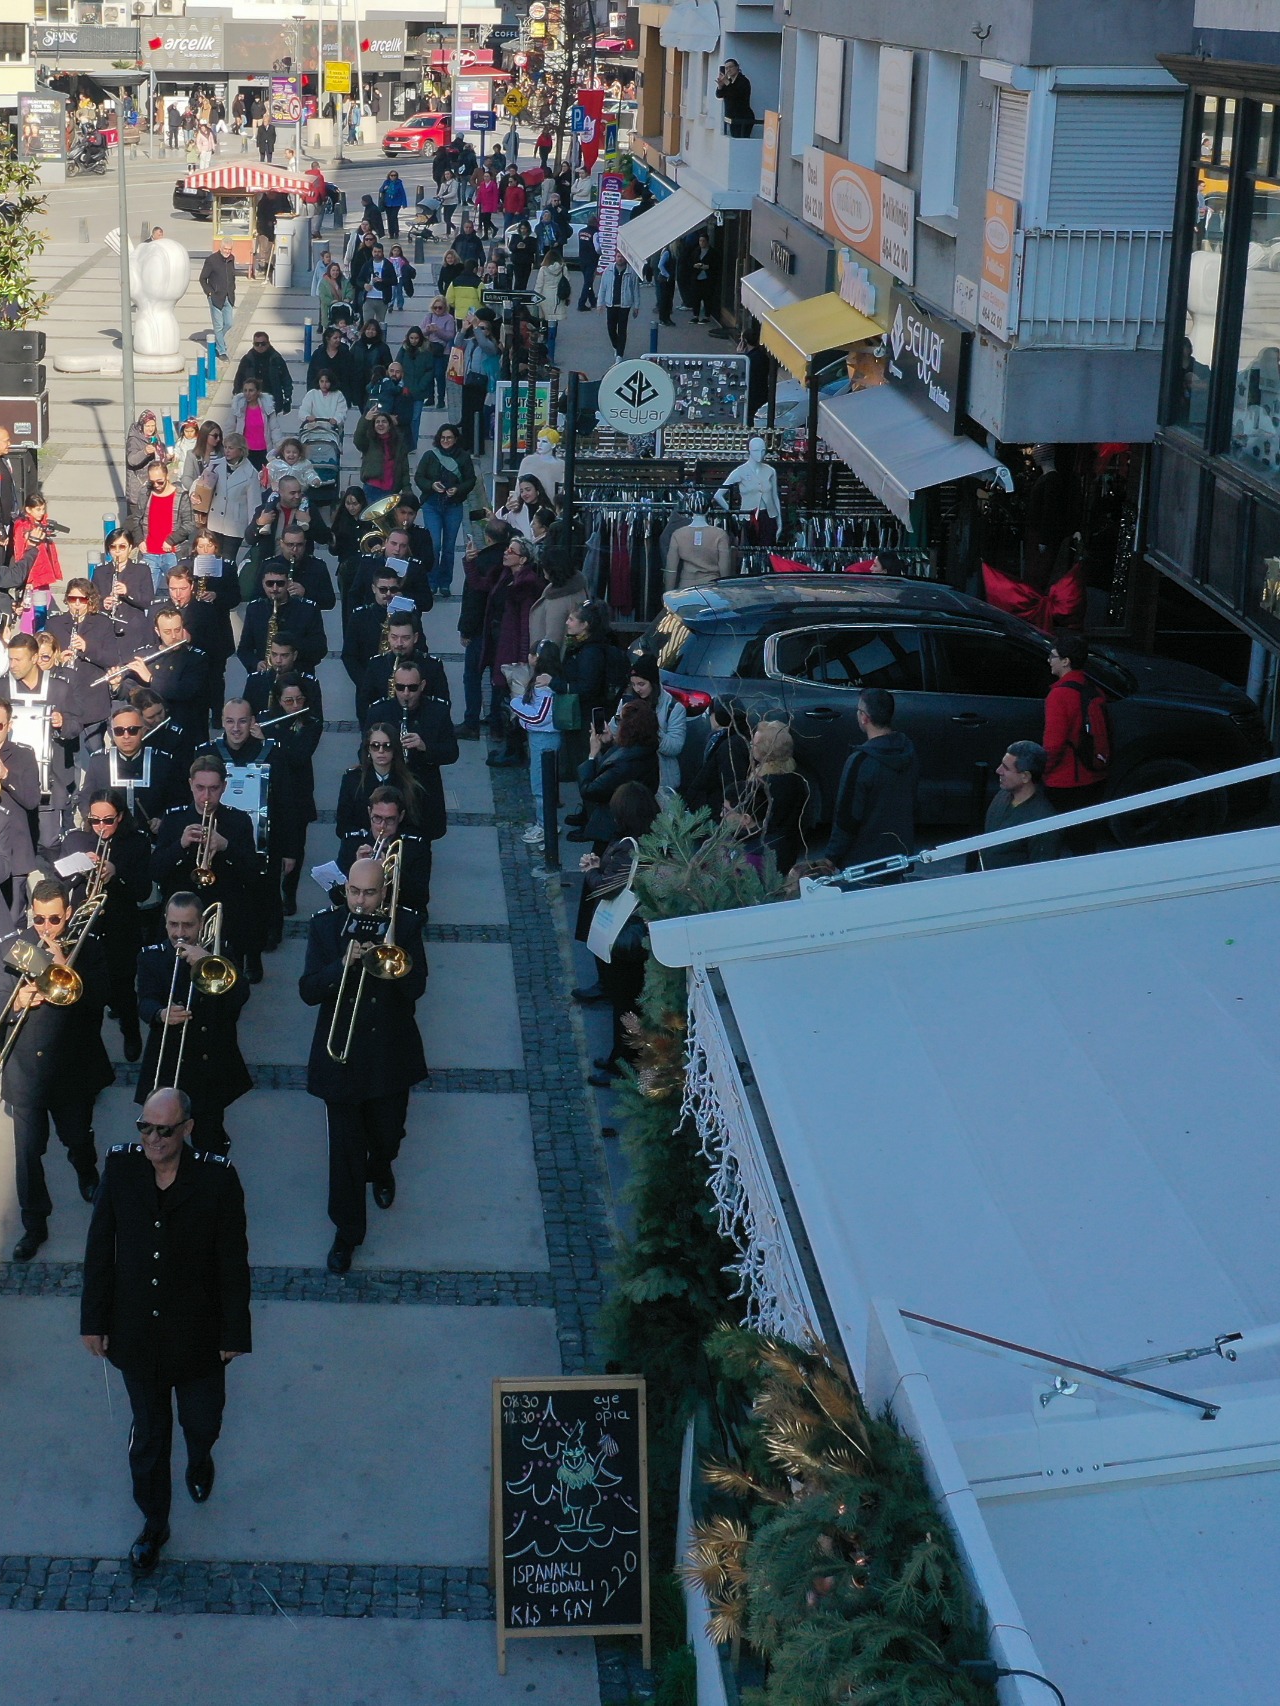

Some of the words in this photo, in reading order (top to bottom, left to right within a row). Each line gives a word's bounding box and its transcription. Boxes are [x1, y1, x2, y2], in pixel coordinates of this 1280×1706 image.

[164, 35, 215, 53] arçelik
[370, 38, 403, 54] arçelik
[574, 108, 582, 130] P
[882, 235, 892, 262] 464
[893, 242, 901, 268] 22
[901, 248, 909, 273] 00
[609, 407, 665, 425] seyyar
[593, 1394, 620, 1411] eye
[595, 1407, 630, 1427] opia
[512, 1561, 581, 1587] ISPANAKLI
[601, 1550, 637, 1607] 220
[527, 1579, 595, 1594] CHEDDARLI
[510, 1602, 541, 1626] KİŞ
[563, 1598, 593, 1623] ÇAY
